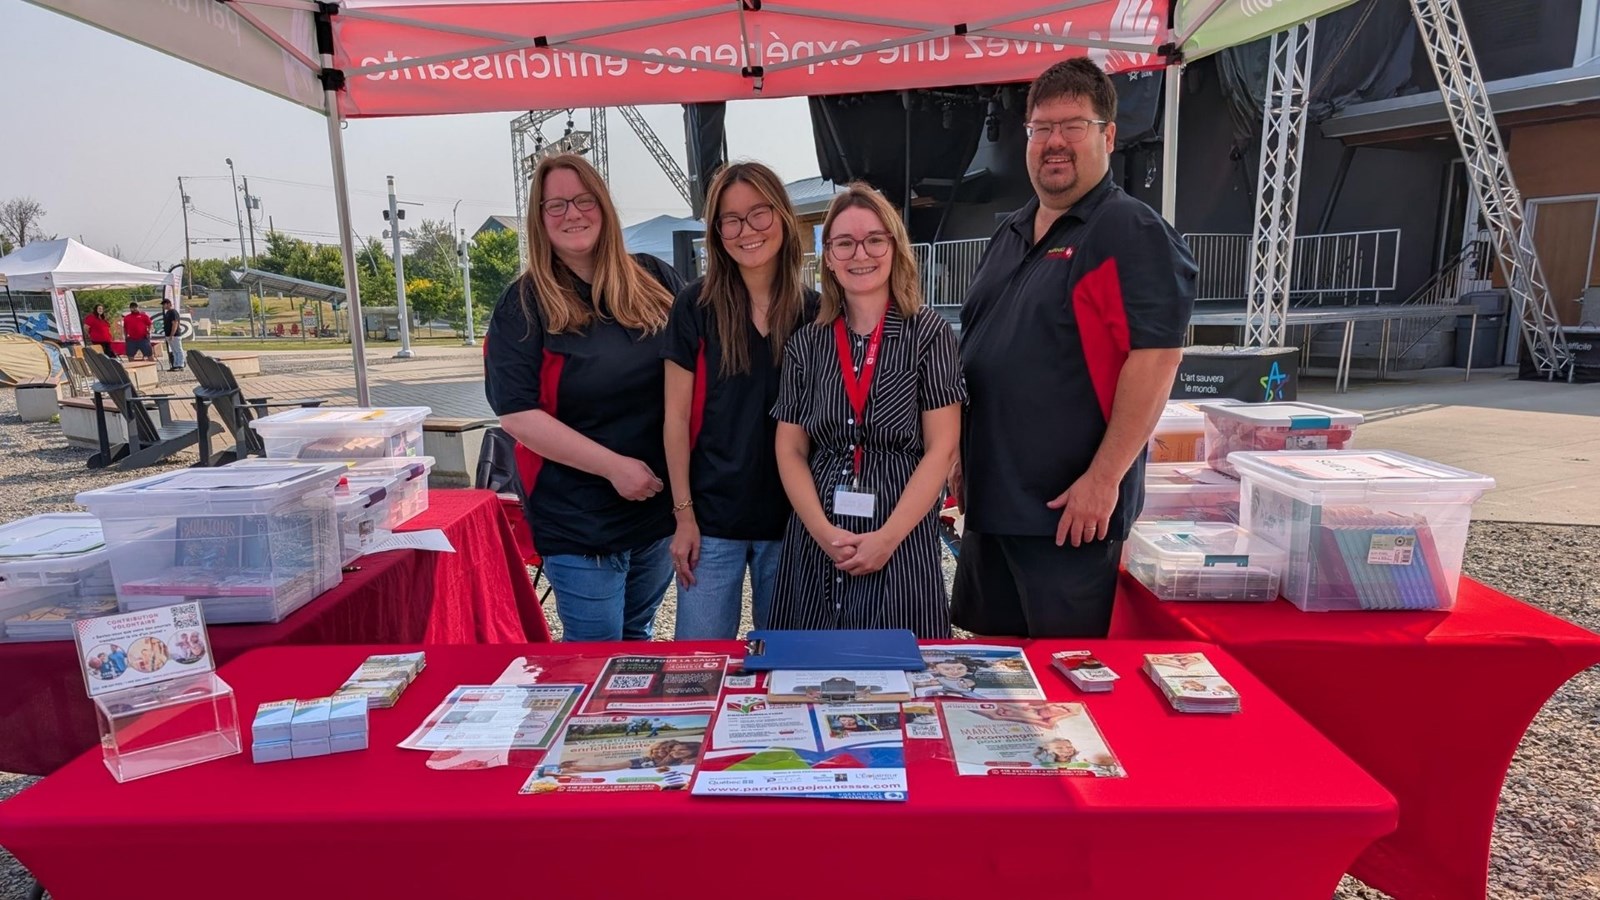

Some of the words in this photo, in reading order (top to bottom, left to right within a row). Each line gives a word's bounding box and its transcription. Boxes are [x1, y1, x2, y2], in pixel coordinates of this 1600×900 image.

[1180, 373, 1196, 382] L'art
[1196, 374, 1224, 383] sauvera
[1184, 384, 1191, 392] le
[1191, 385, 1219, 394] monde.
[106, 613, 159, 626] CONTRIBUTION
[111, 619, 156, 630] VOLONTAIRE
[569, 743, 651, 752] enrichissante
[707, 783, 901, 792] www.parrainagejeunesse.com
